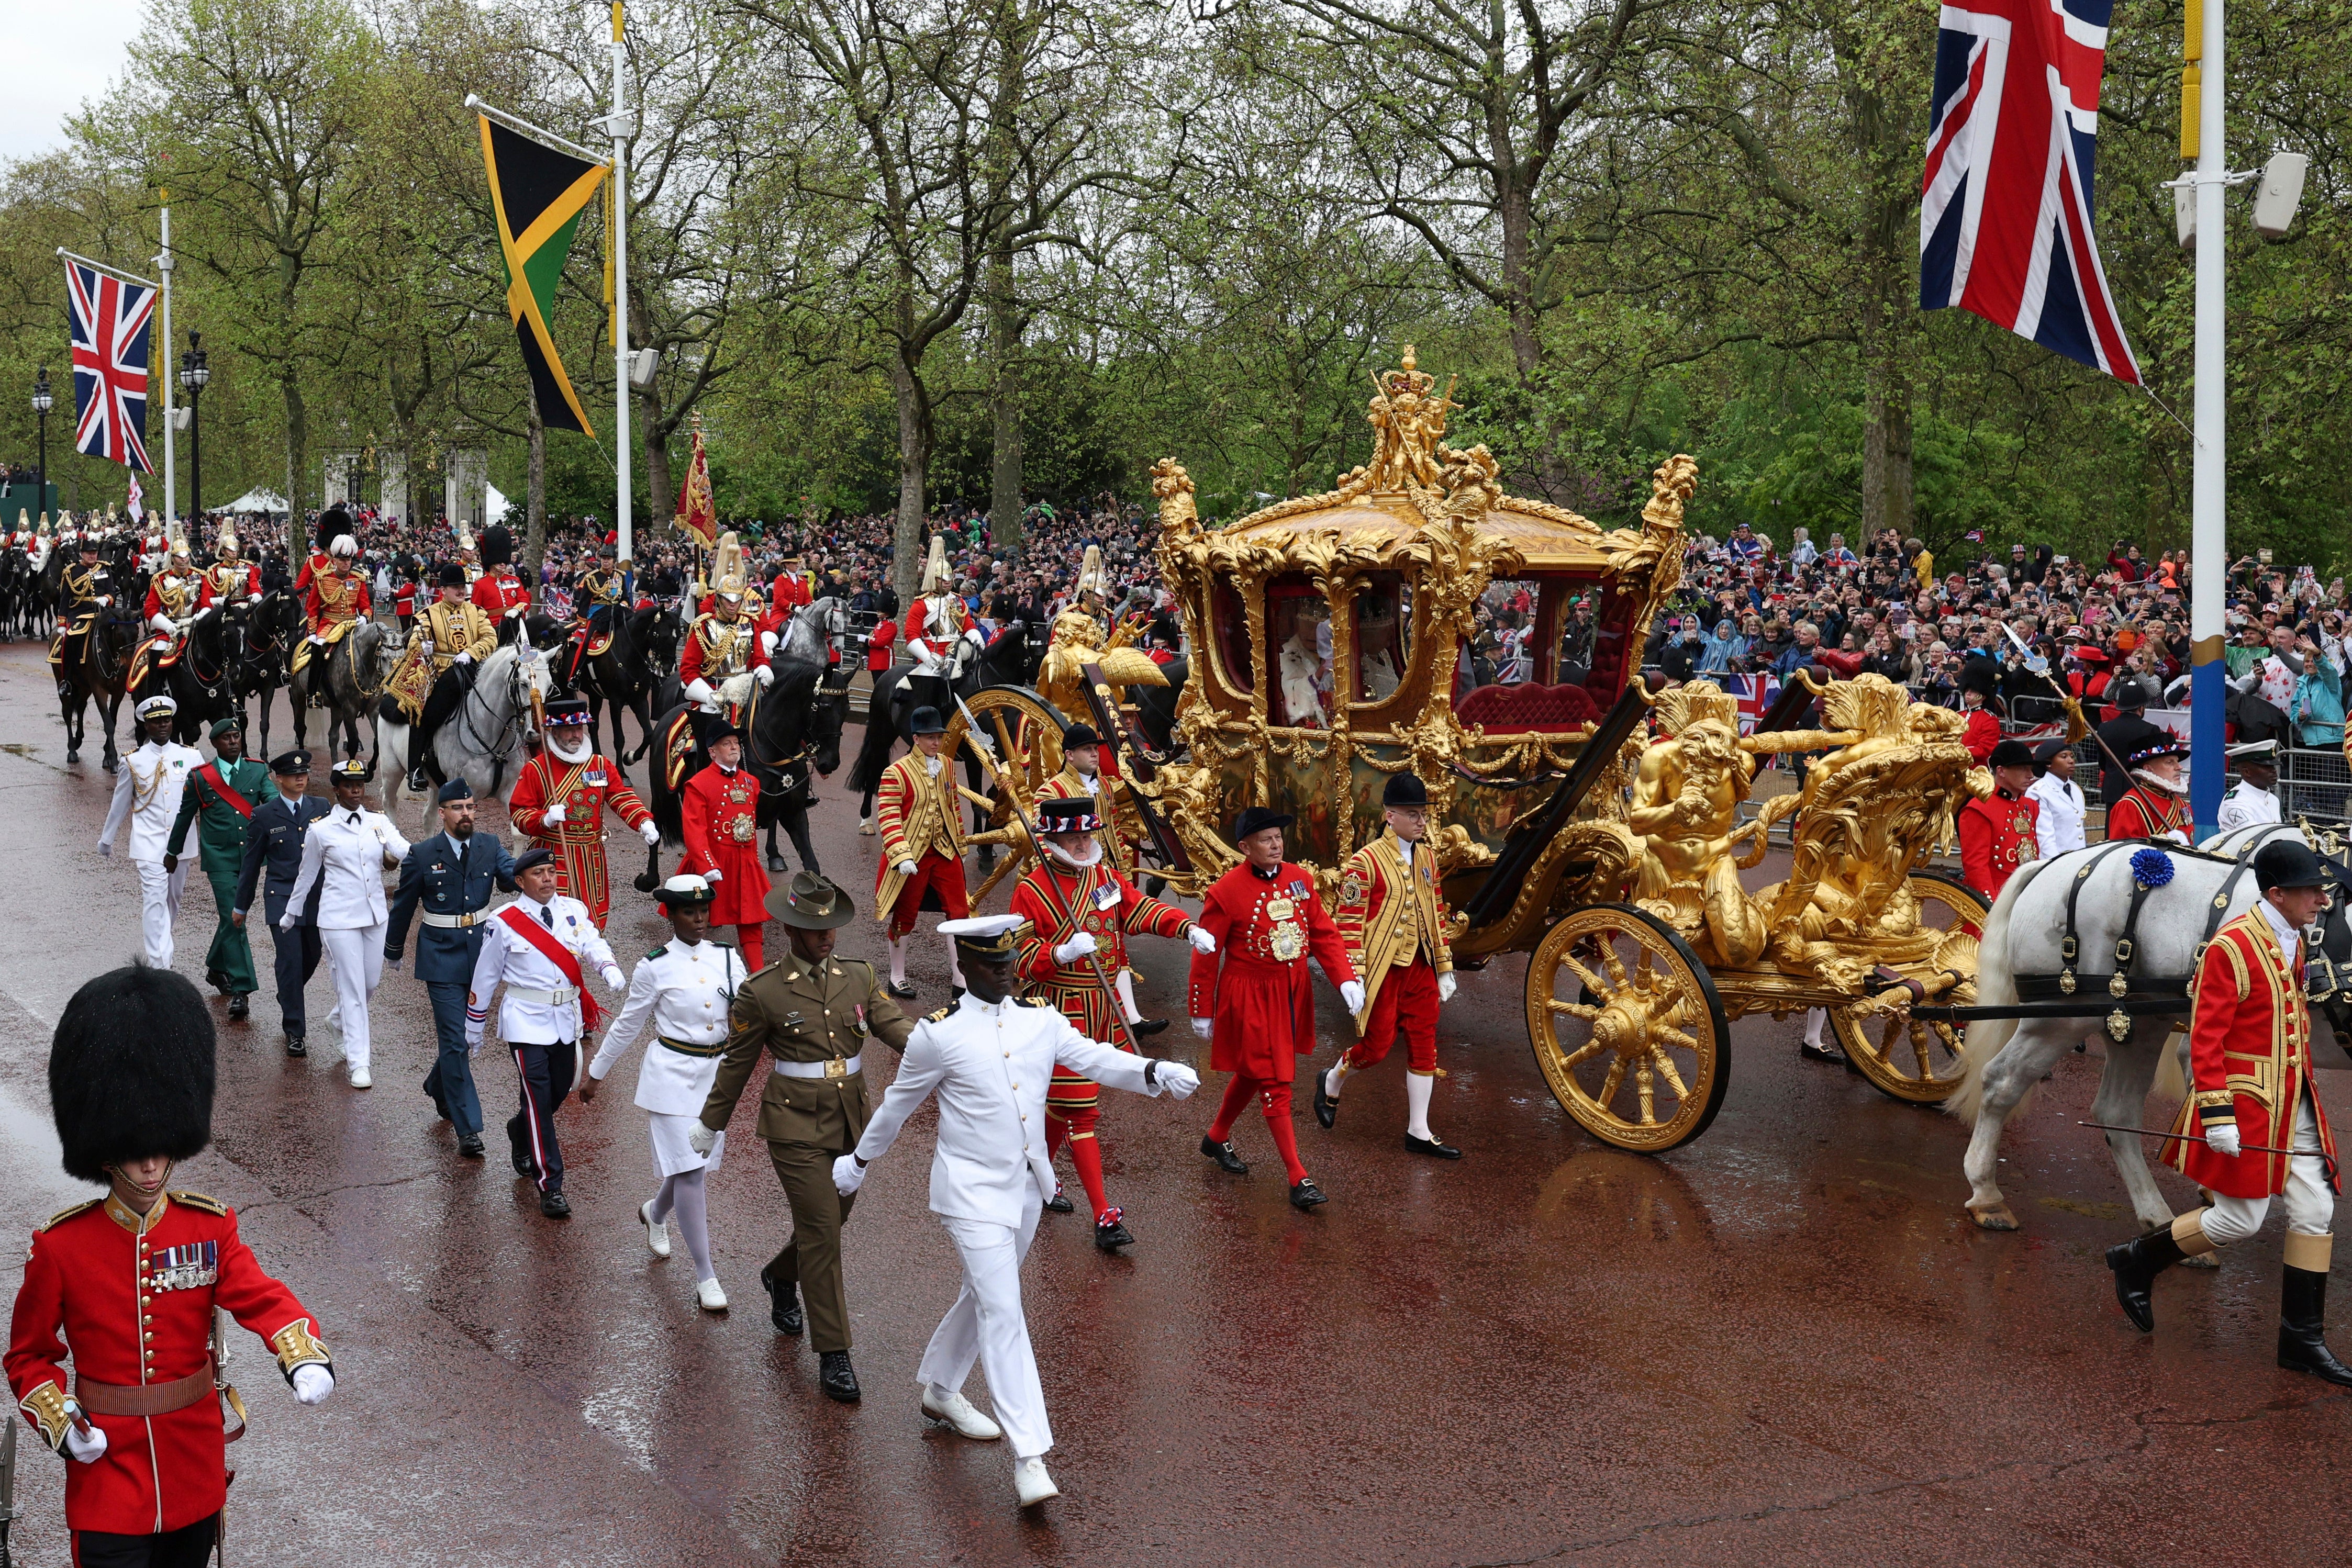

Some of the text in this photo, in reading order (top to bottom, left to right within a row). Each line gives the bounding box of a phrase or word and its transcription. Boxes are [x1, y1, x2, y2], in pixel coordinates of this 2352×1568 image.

[722, 821, 731, 834] C
[2006, 848, 2016, 863] C
[1257, 935, 1269, 952] C
